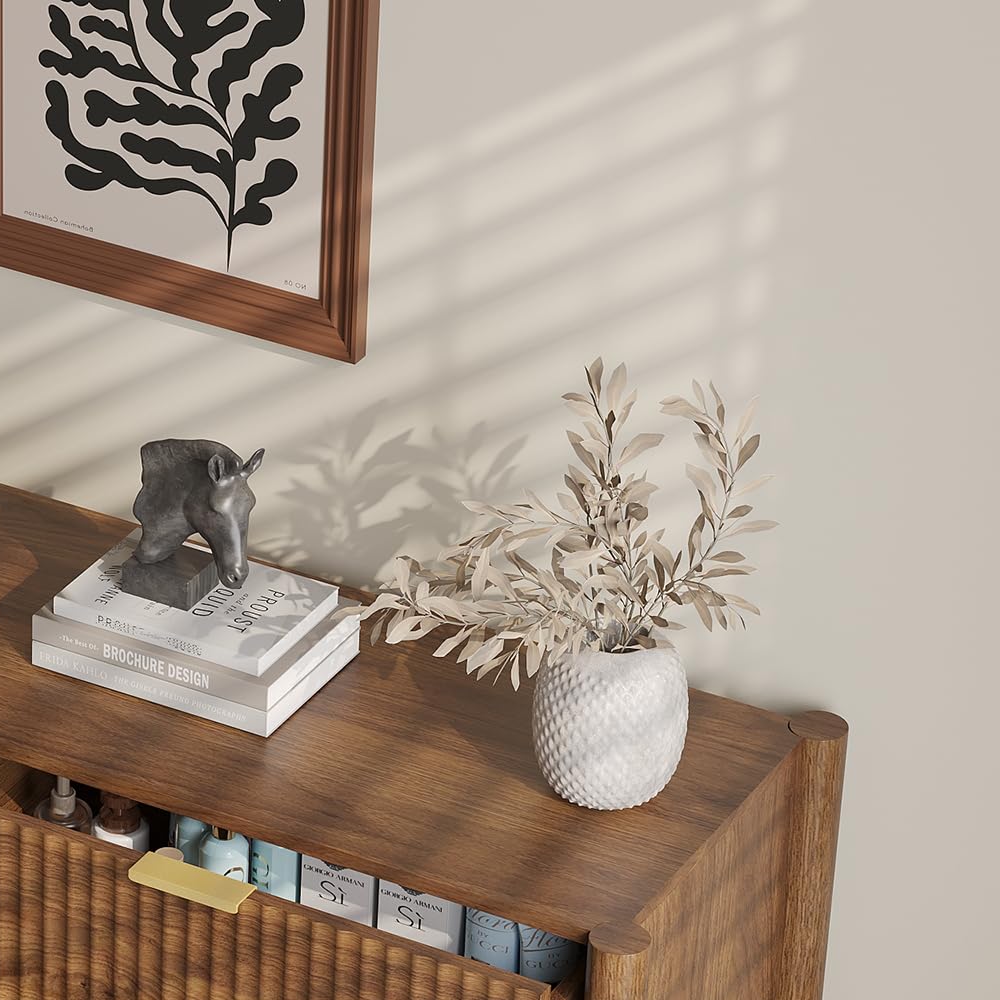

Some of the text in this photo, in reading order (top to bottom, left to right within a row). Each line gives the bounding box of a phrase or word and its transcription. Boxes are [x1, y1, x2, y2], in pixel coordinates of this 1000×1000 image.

[192, 588, 235, 617] QUID
[223, 593, 249, 615] and the
[227, 588, 285, 633] PROUST
[73, 638, 88, 648] Best
[39, 651, 70, 669] FRIDA
[72, 660, 108, 680] KAHLO
[103, 643, 165, 676] BROCHURE
[167, 663, 210, 689] DESIGN
[303, 863, 365, 888] GIORGIO ARMANI
[318, 880, 349, 907] Sì
[380, 888, 443, 913] GIORGIO ARMANI
[395, 905, 426, 932] Sì
